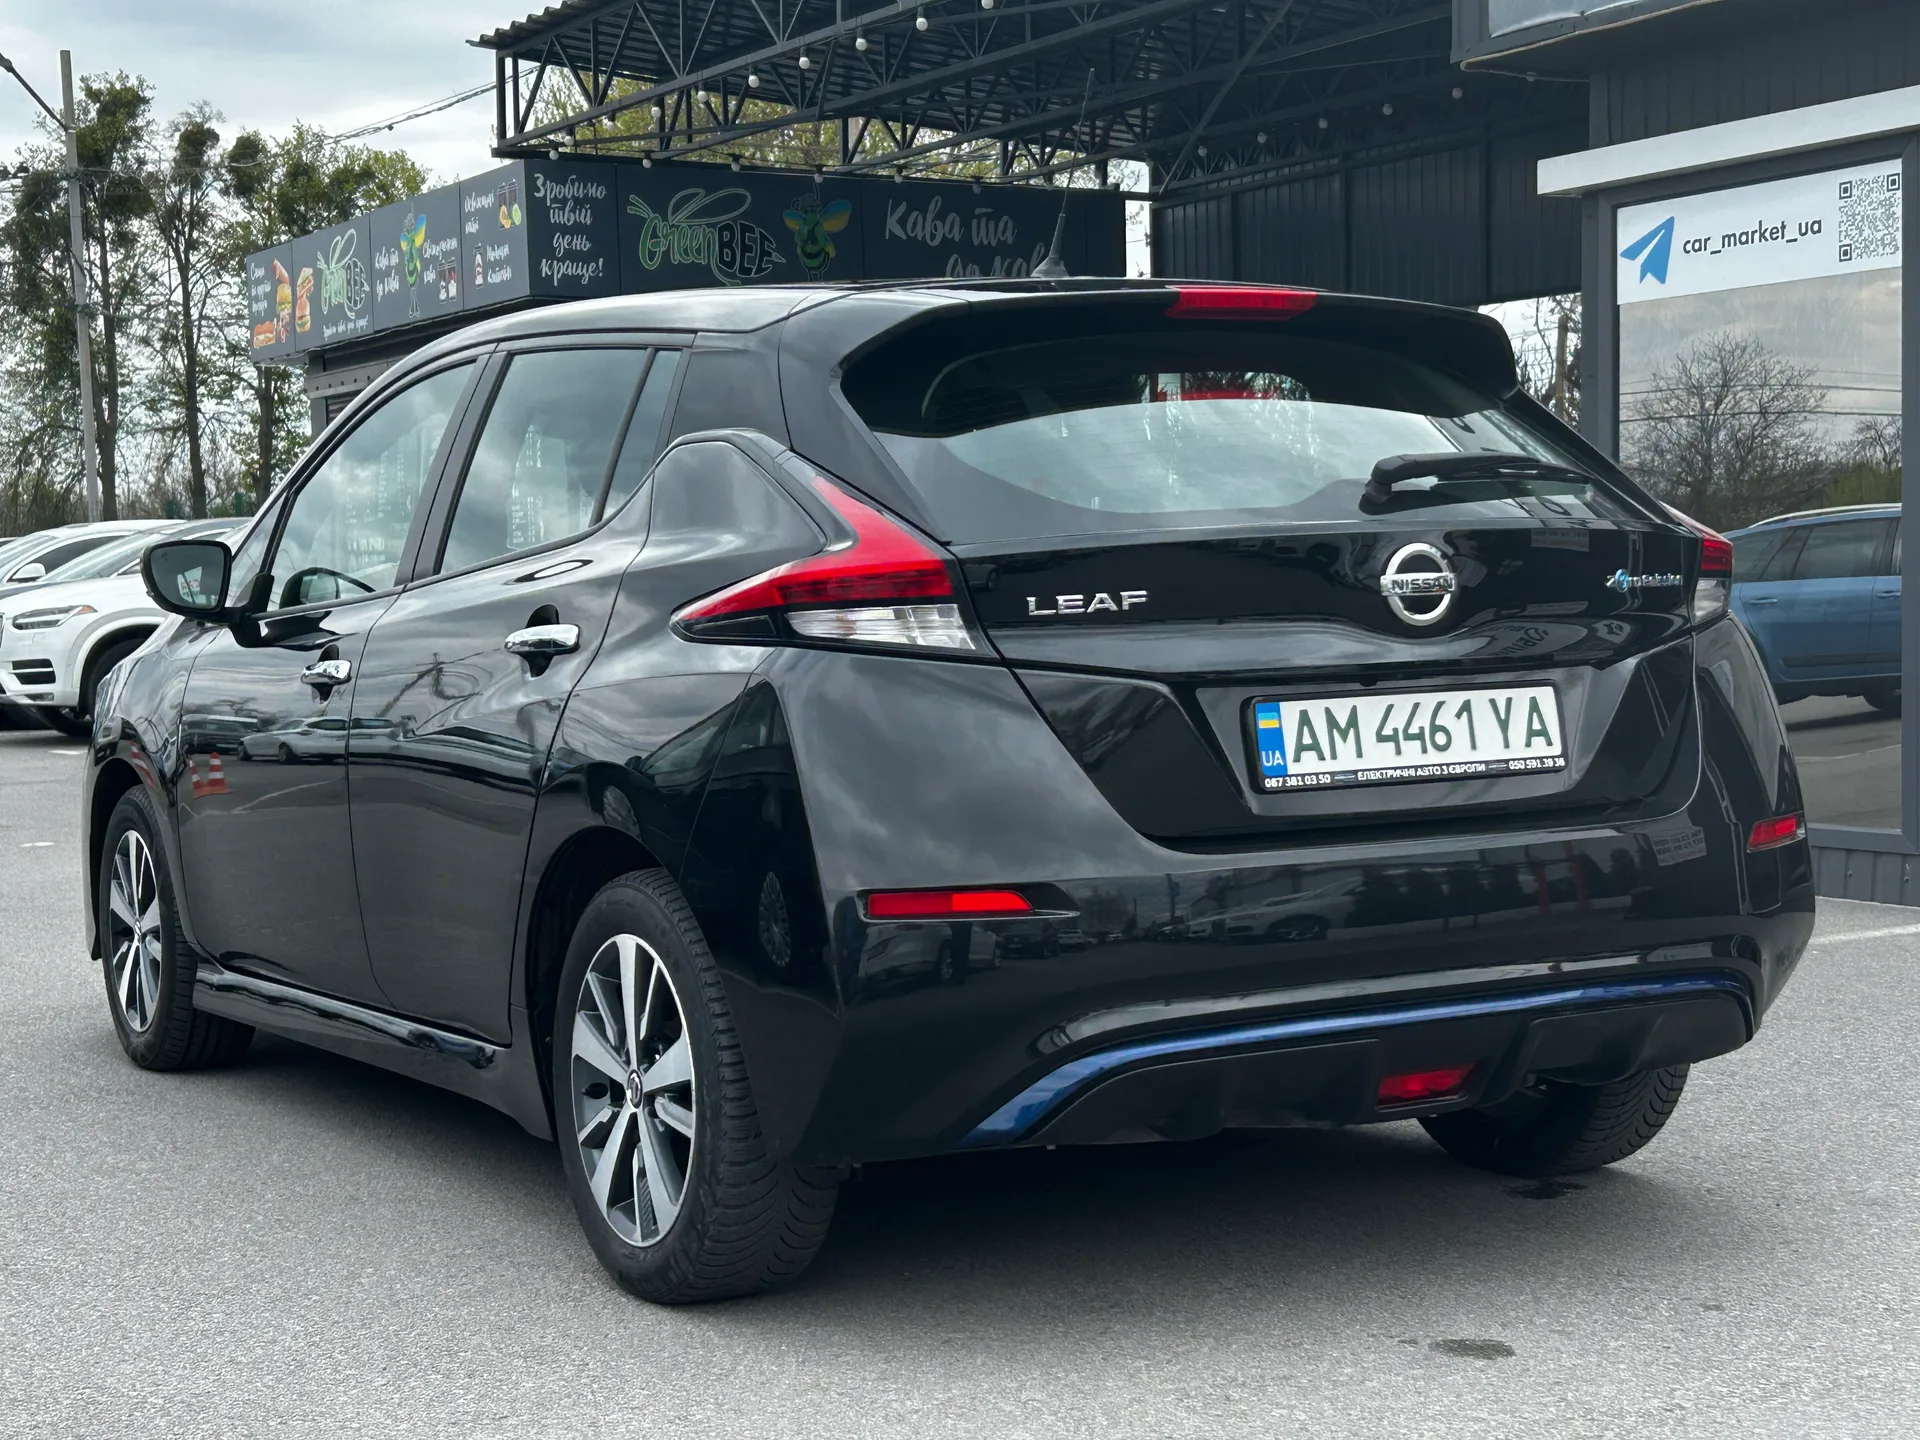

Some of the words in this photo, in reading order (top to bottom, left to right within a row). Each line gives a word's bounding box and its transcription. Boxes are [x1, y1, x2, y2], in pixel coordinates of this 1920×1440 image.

[534, 173, 607, 207] Зробимо
[550, 200, 593, 226] твій
[885, 195, 965, 247] Кава
[971, 208, 1018, 247] та
[553, 232, 592, 257] день
[1682, 219, 1823, 255] car_market_ua
[540, 258, 604, 287] краще!
[990, 242, 1045, 278] кав
[1391, 576, 1454, 592] NISSAN
[1026, 590, 1148, 616] LEAF
[1292, 704, 1363, 763] AM
[1375, 699, 1477, 756] 4461
[1488, 695, 1554, 750] YA
[1261, 750, 1284, 767] UA
[1305, 774, 1317, 785] 03
[1318, 773, 1331, 784] 50
